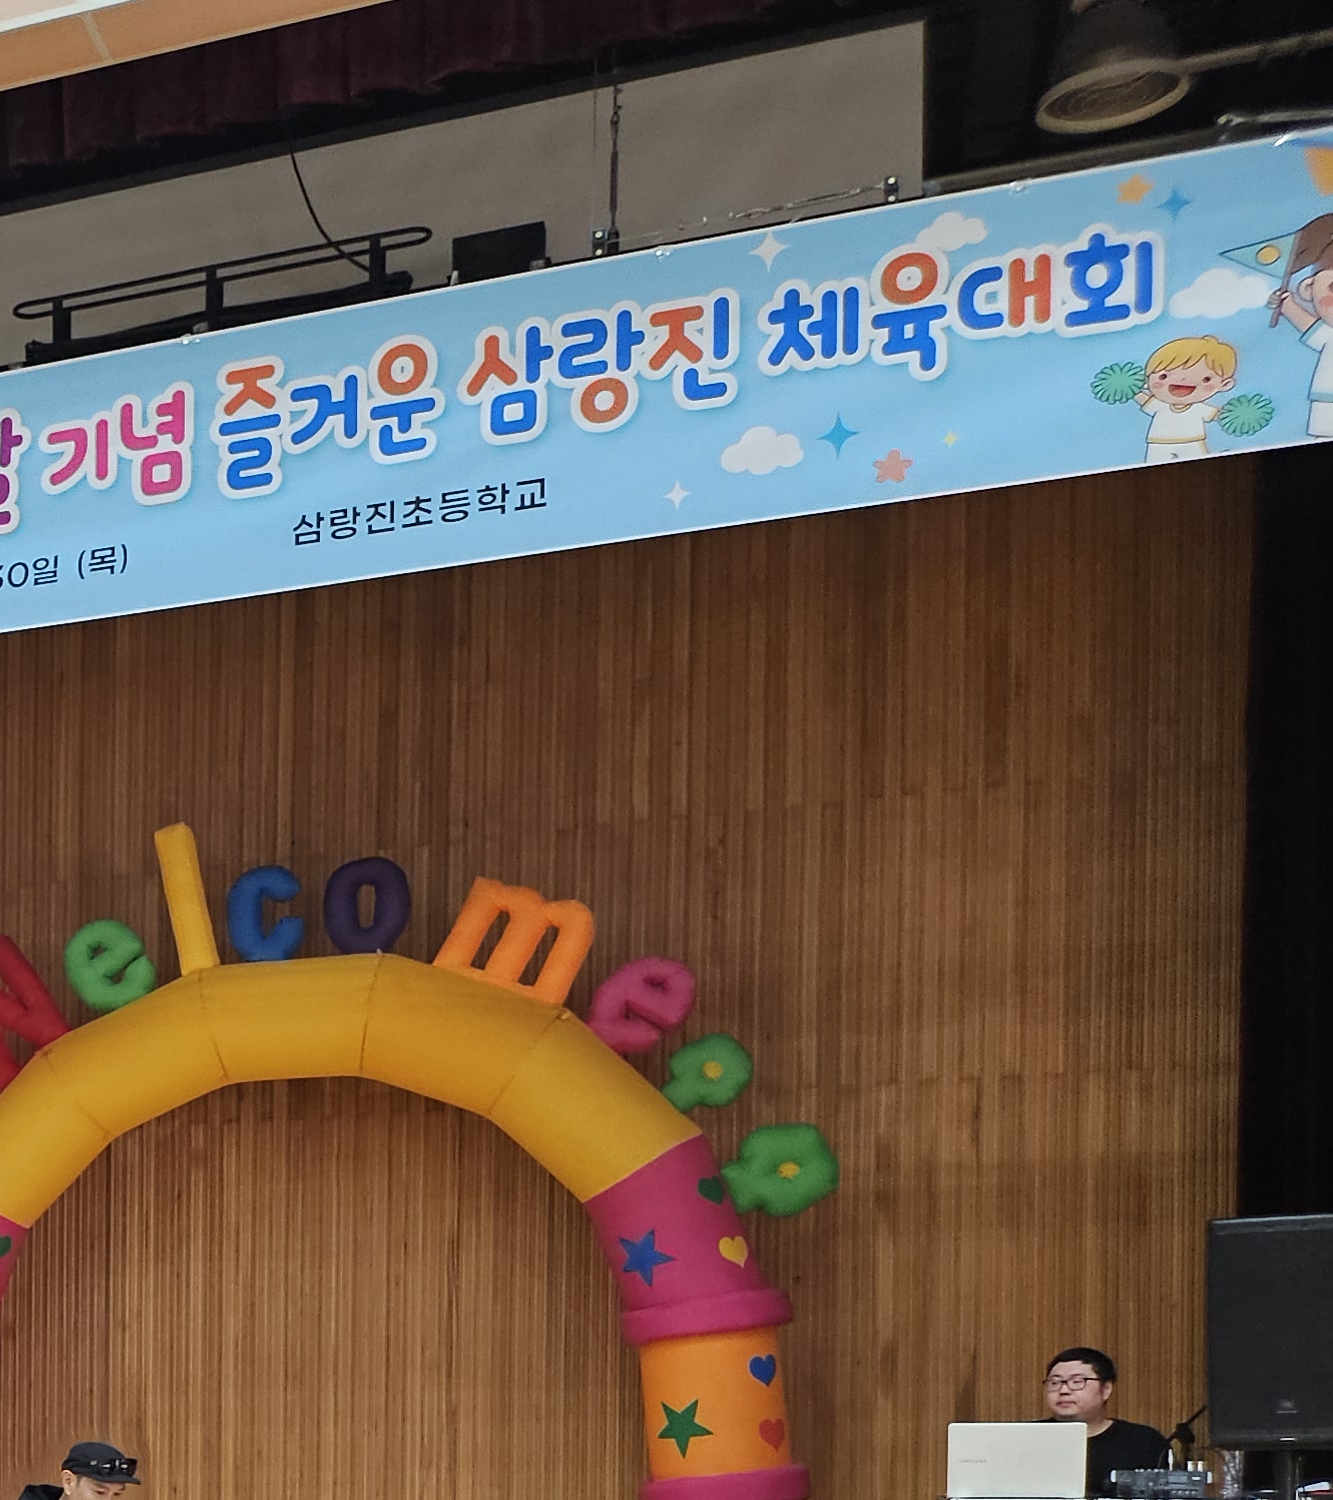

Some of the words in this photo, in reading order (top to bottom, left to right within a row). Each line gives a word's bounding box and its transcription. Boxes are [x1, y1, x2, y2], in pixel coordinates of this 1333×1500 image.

[46, 389, 187, 496] 기념
[218, 343, 436, 492] 즐거운
[466, 296, 731, 437] 삼랑진
[767, 231, 1155, 372] 체육대회
[292, 477, 548, 546] 삼랑진초등학교
[77, 543, 129, 580] (목)
